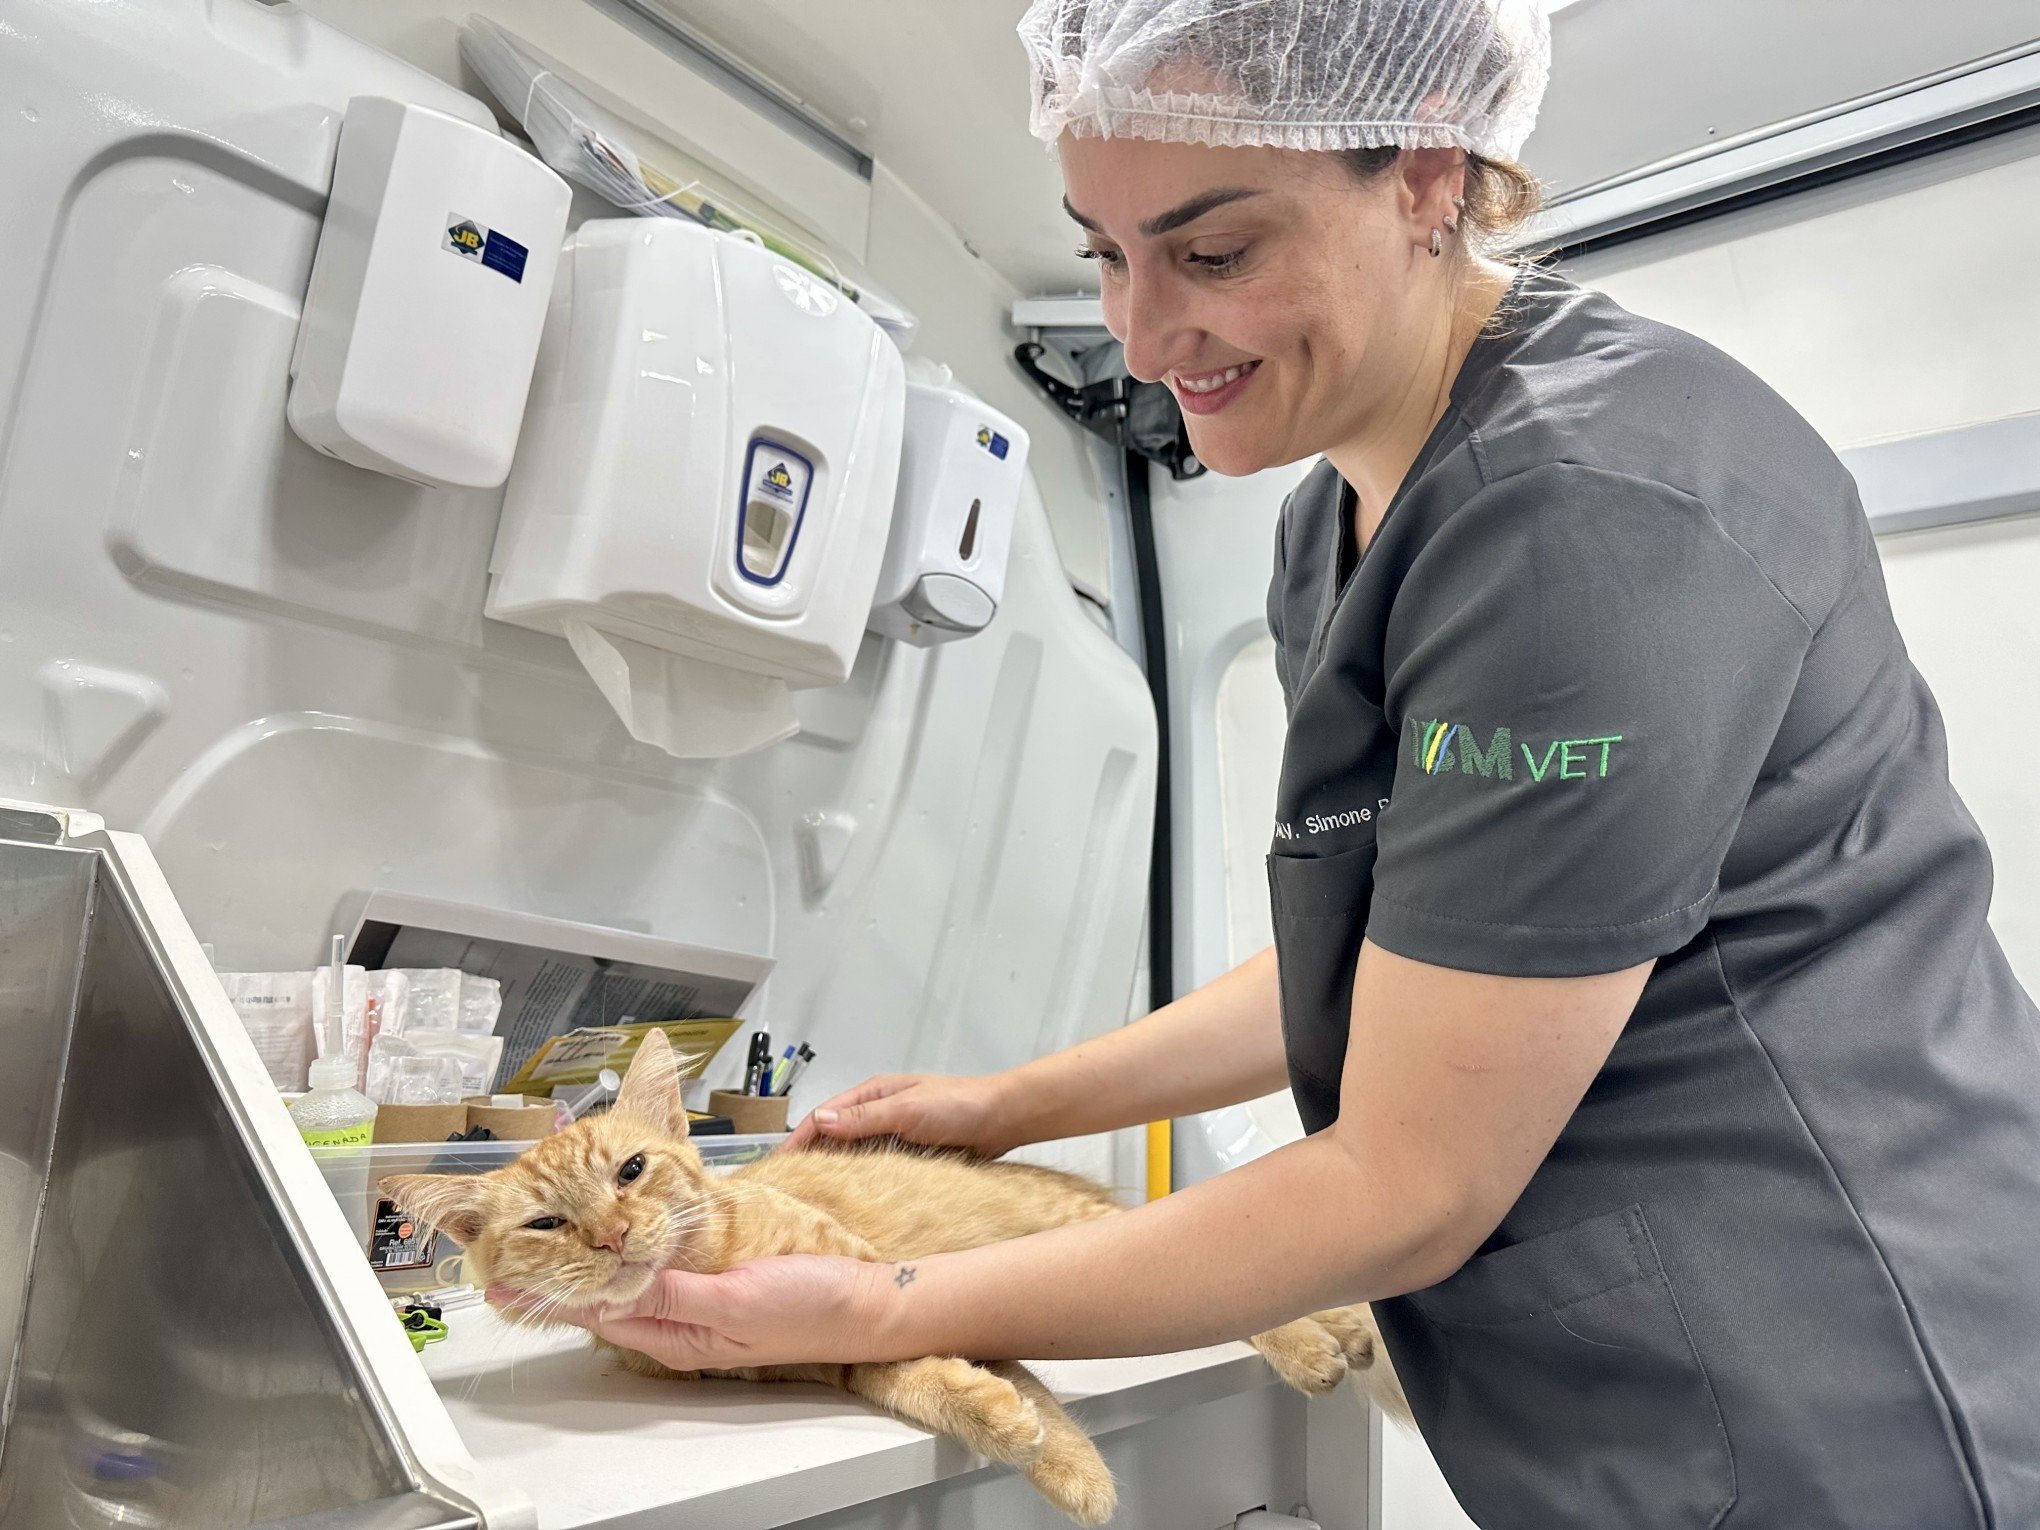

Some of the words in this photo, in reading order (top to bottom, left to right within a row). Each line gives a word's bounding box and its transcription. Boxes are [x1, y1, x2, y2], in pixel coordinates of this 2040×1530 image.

[453, 230, 480, 248] JB
[771, 470, 789, 488] JB
[1520, 735, 1623, 782] VET
[1305, 807, 1372, 835] Simone
